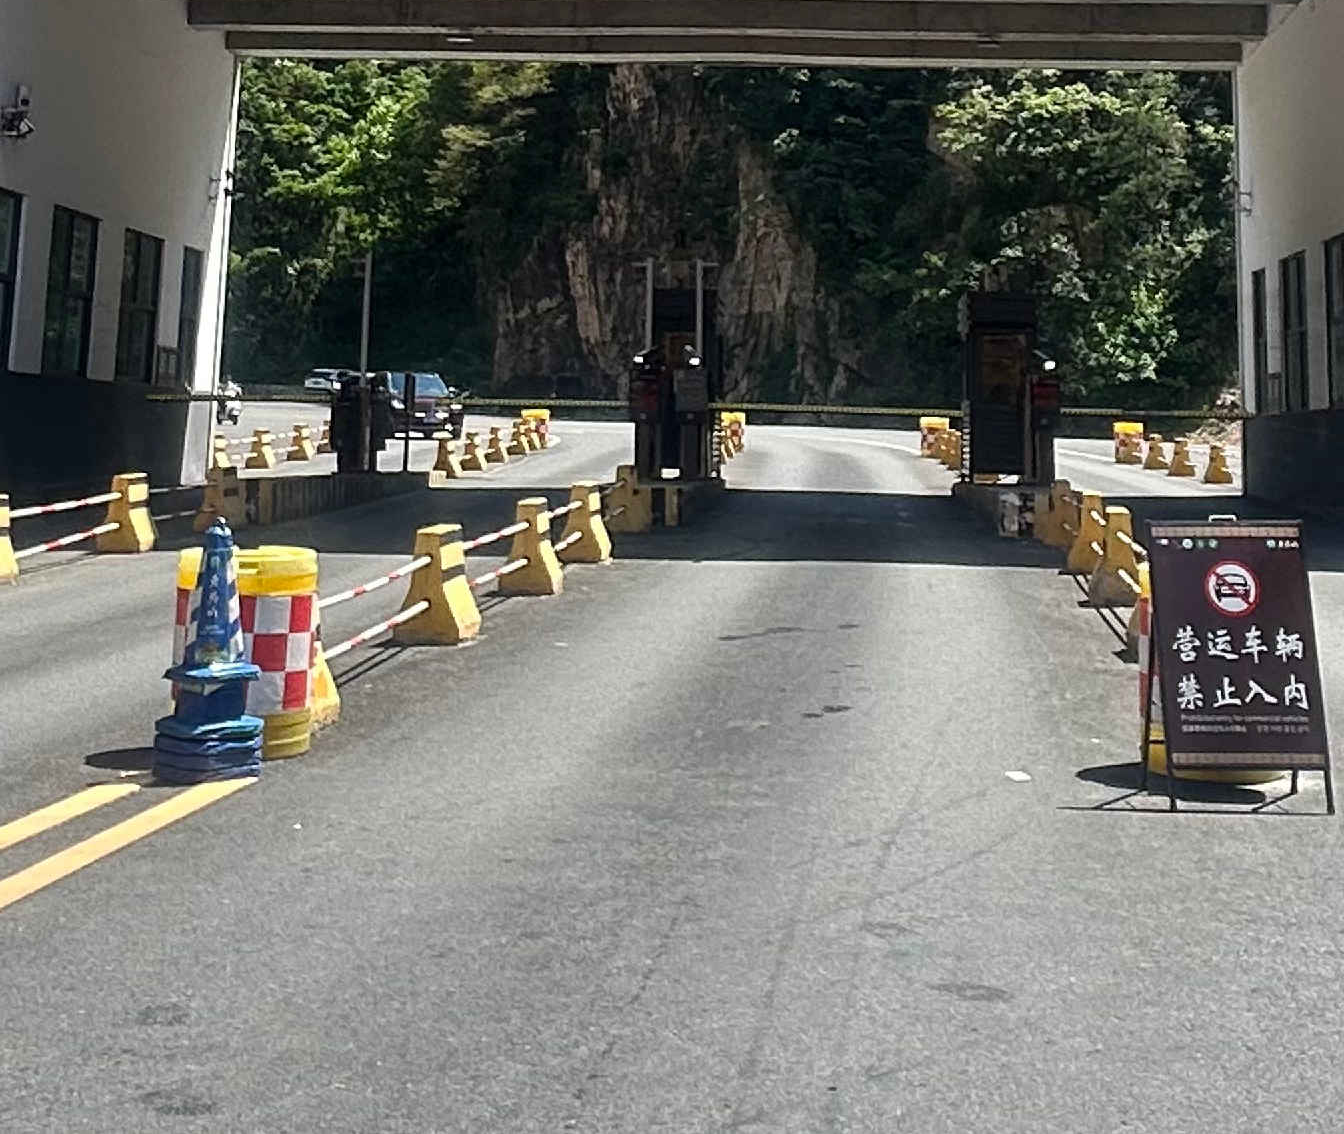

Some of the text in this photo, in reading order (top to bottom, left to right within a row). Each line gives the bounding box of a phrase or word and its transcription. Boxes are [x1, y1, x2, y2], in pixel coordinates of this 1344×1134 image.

[1171, 625, 1305, 663] 营运车辆
[1175, 673, 1310, 711] 禁止入内
